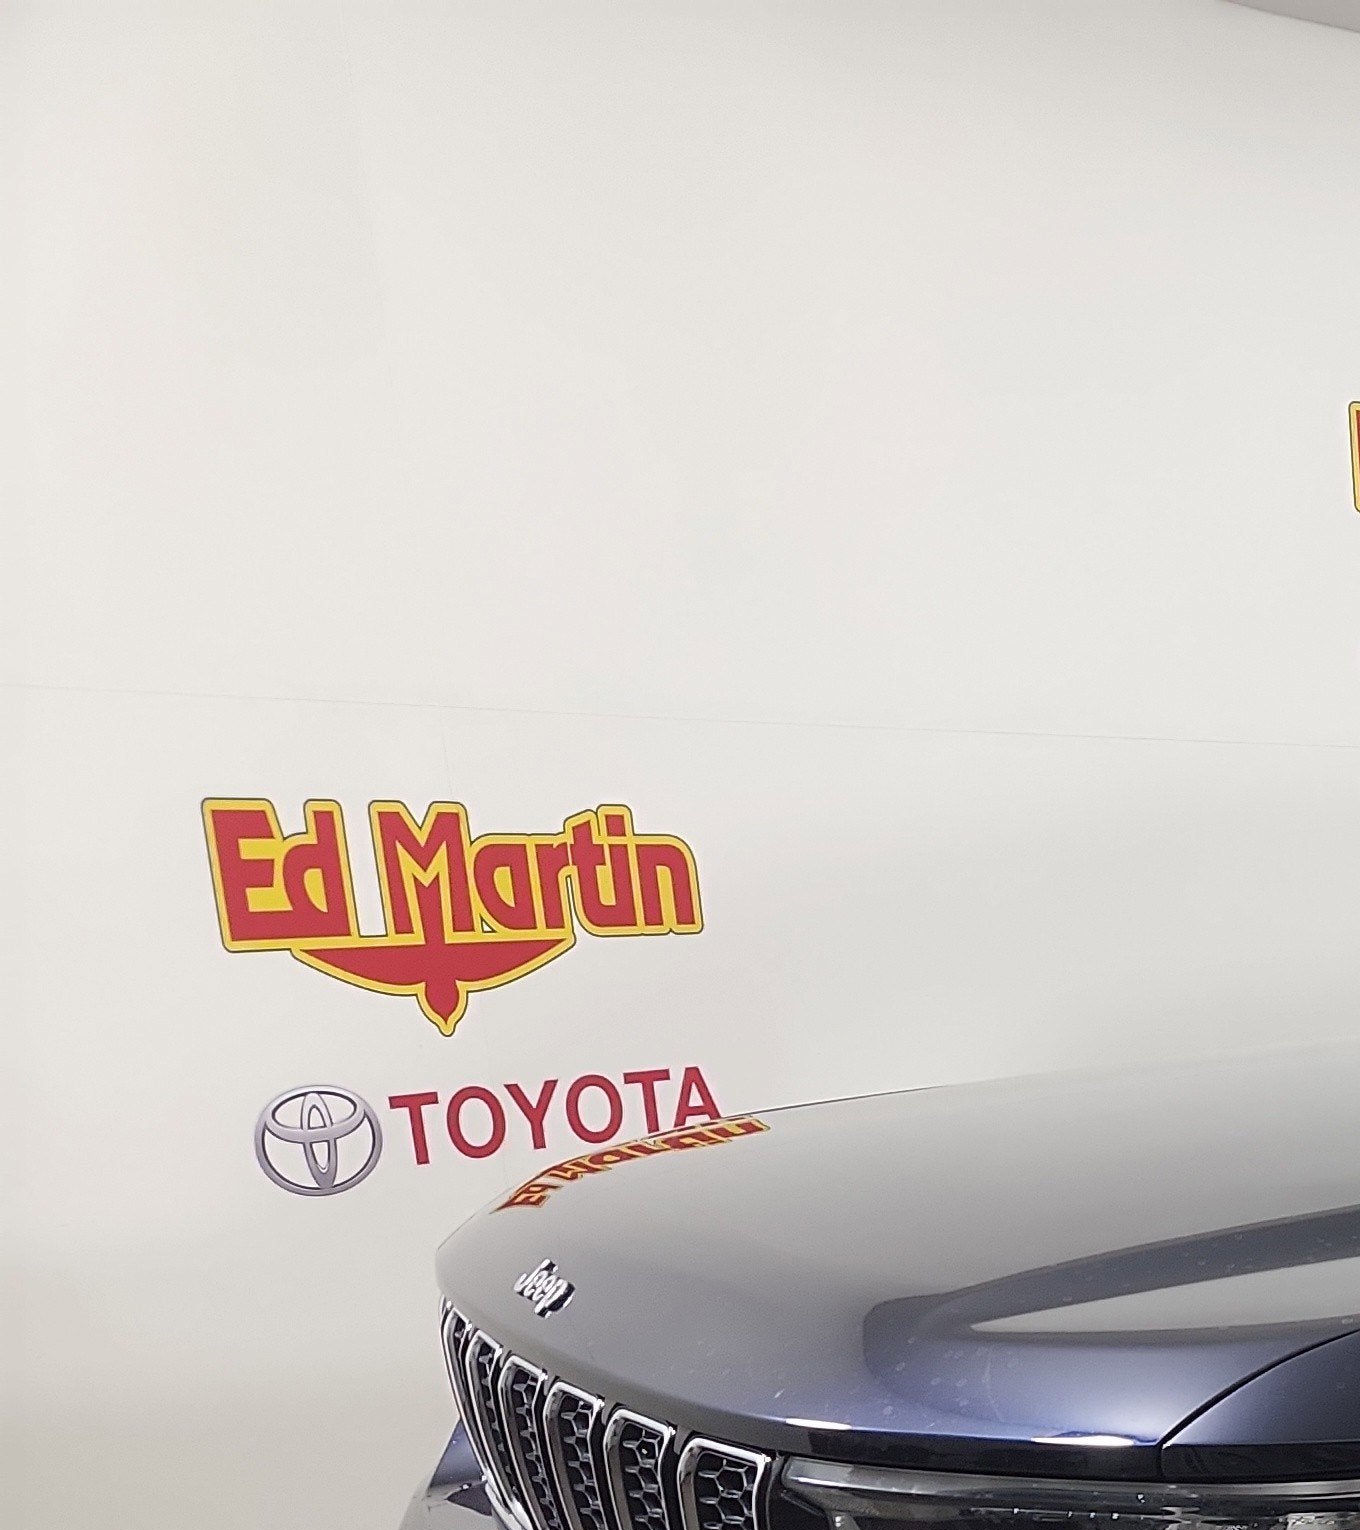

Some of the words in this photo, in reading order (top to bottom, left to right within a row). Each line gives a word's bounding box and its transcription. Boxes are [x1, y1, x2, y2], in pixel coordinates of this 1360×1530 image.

[206, 804, 356, 947] Ed
[372, 804, 700, 938] Martin
[388, 1066, 722, 1166] TOYOTA
[513, 1258, 572, 1318] Jeep
